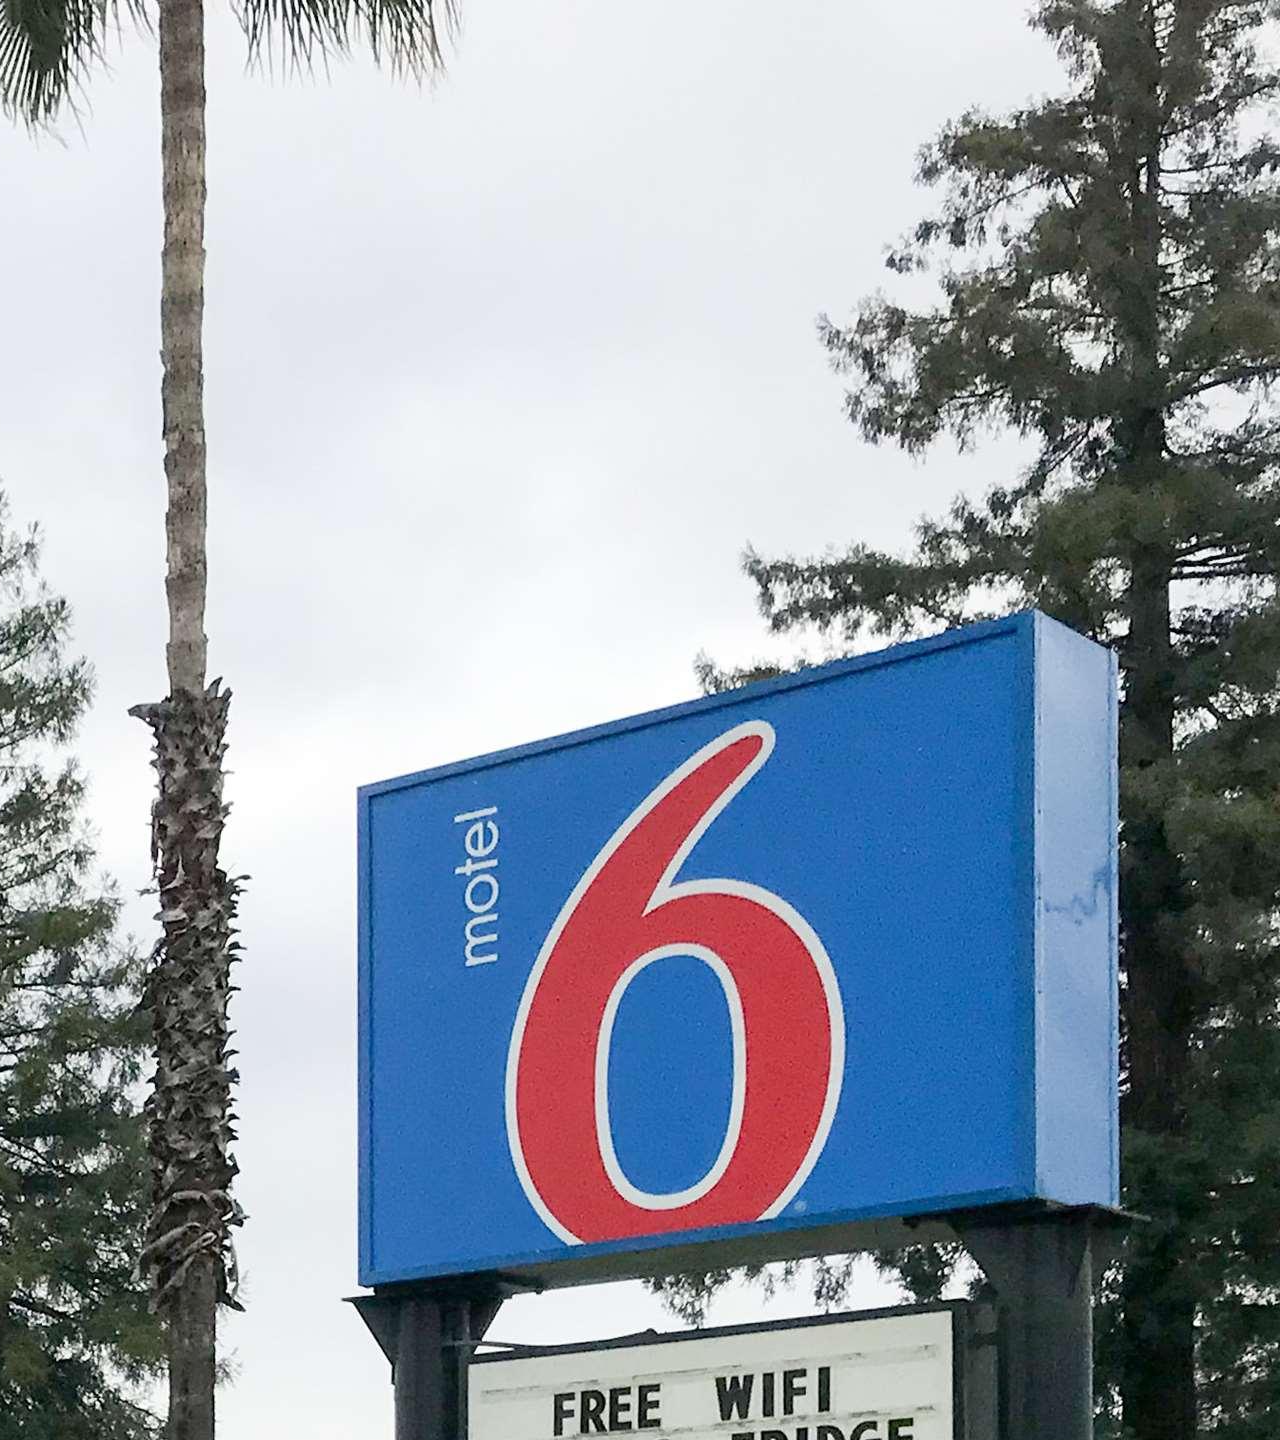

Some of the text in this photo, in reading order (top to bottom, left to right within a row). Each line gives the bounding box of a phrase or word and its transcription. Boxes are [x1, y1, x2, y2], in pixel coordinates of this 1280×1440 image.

[454, 719, 845, 1246] motel 6
[553, 1366, 831, 1436] FREE WIFI
